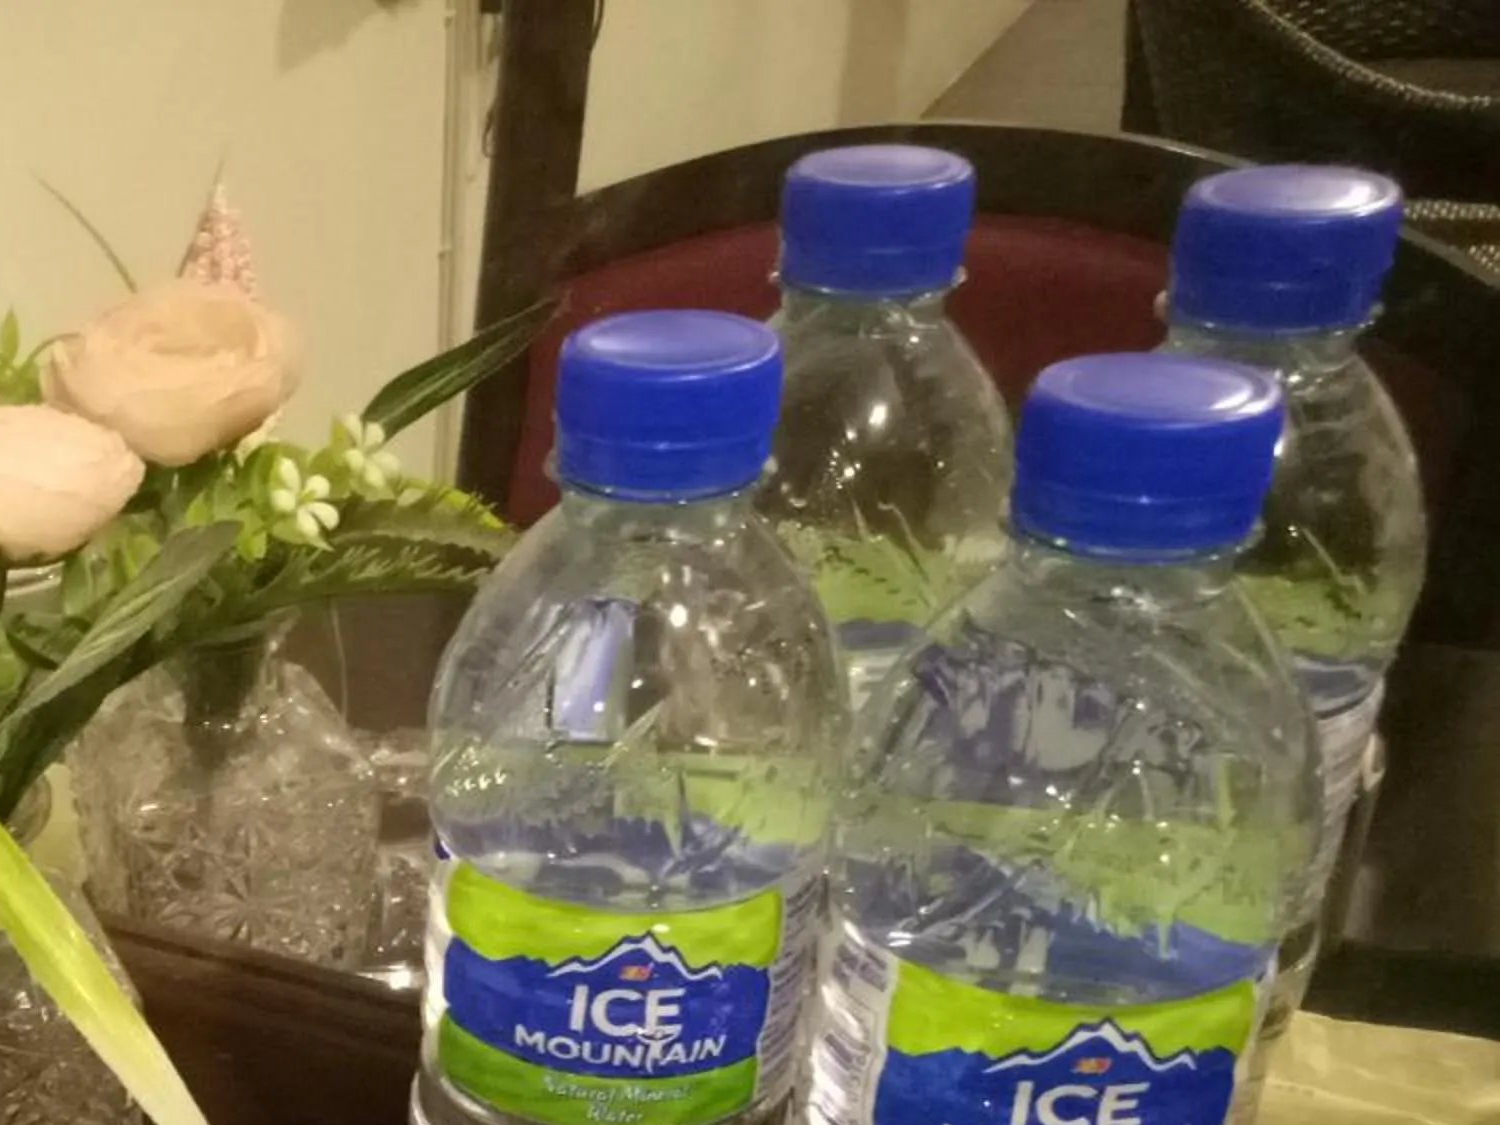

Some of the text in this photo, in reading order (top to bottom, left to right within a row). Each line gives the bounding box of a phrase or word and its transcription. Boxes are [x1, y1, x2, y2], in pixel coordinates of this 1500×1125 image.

[569, 984, 688, 1037] ICE
[514, 1024, 727, 1073] MOUNTAIN
[585, 1102, 645, 1123] Water
